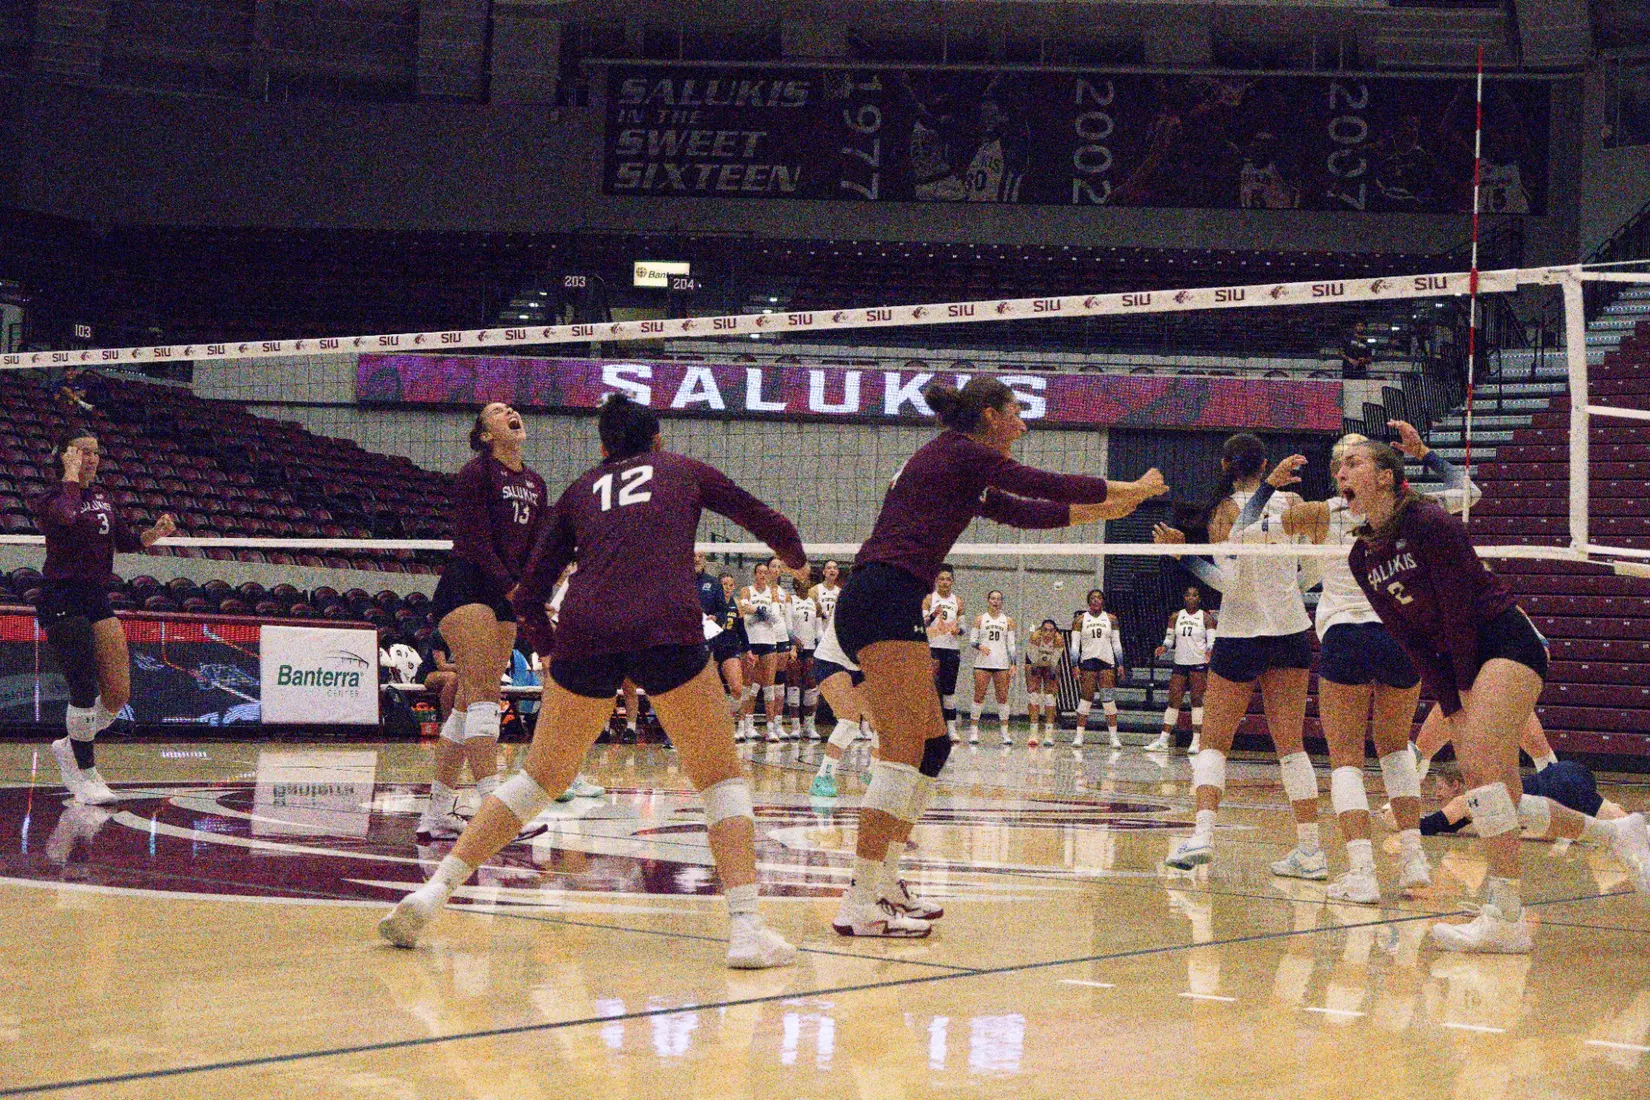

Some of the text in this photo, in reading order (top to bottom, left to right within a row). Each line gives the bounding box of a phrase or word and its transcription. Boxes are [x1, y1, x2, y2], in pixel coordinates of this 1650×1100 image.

[617, 78, 811, 107] SALUKIS
[616, 109, 703, 125] IN THE
[615, 128, 768, 158] SWEET
[841, 75, 882, 201] 1977
[1073, 78, 1115, 205] 2002
[1327, 82, 1369, 211] 2007
[613, 162, 802, 193] SIXTEEN
[564, 275, 586, 288] 203
[673, 278, 694, 290] 204
[4, 276, 1447, 365] SIU SIU SIU SIU SIU SIU SIU SIU SIU SIU SIU SIU SIU SIU SIU SIU SIU SIU SIU SIU SIU
[74, 323, 91, 339] 103
[597, 363, 1048, 420] SALUKS
[592, 464, 654, 512] 12
[97, 513, 110, 535] 3
[512, 500, 530, 525] 13
[1387, 581, 1414, 605] 2
[988, 630, 1000, 642] 20
[1182, 626, 1193, 637] 17
[277, 664, 360, 688] Banterra
